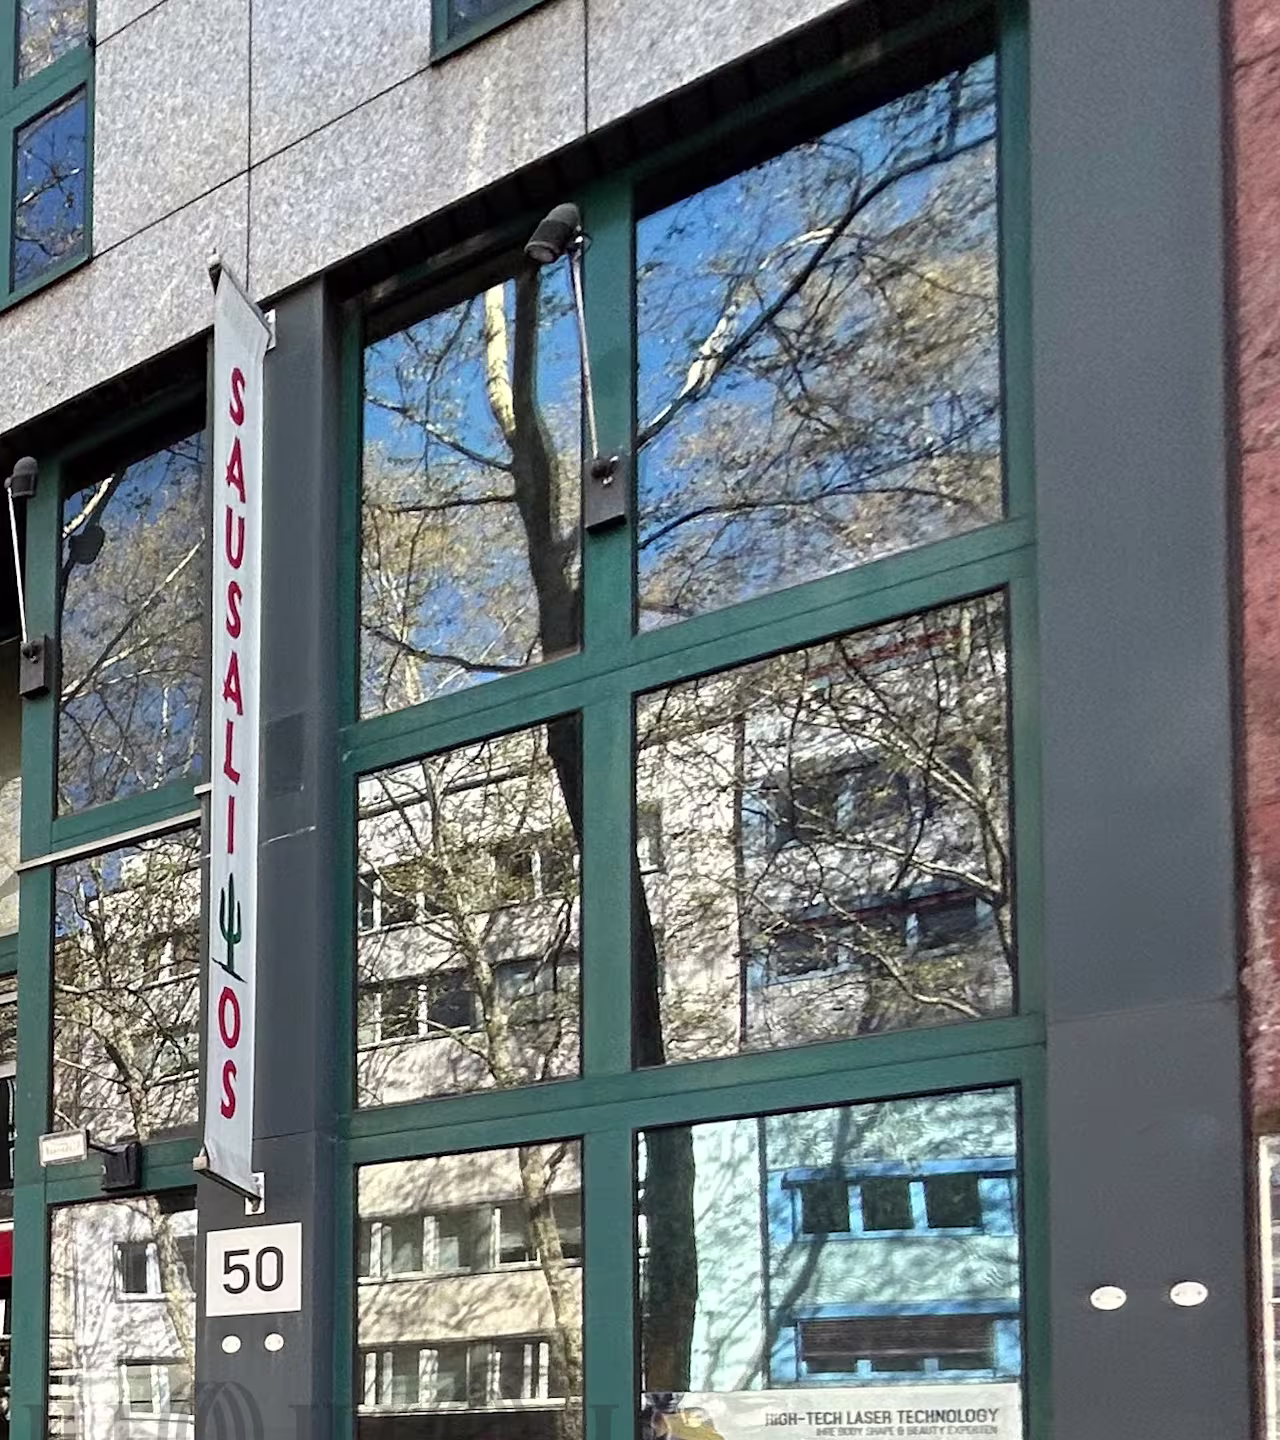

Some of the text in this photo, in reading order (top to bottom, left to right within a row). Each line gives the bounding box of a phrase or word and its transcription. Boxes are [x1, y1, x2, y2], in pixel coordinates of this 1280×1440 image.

[222, 1245, 284, 1294] 50
[846, 1409, 892, 1425] LASER
[898, 1407, 1000, 1424] TECHNOLOGY
